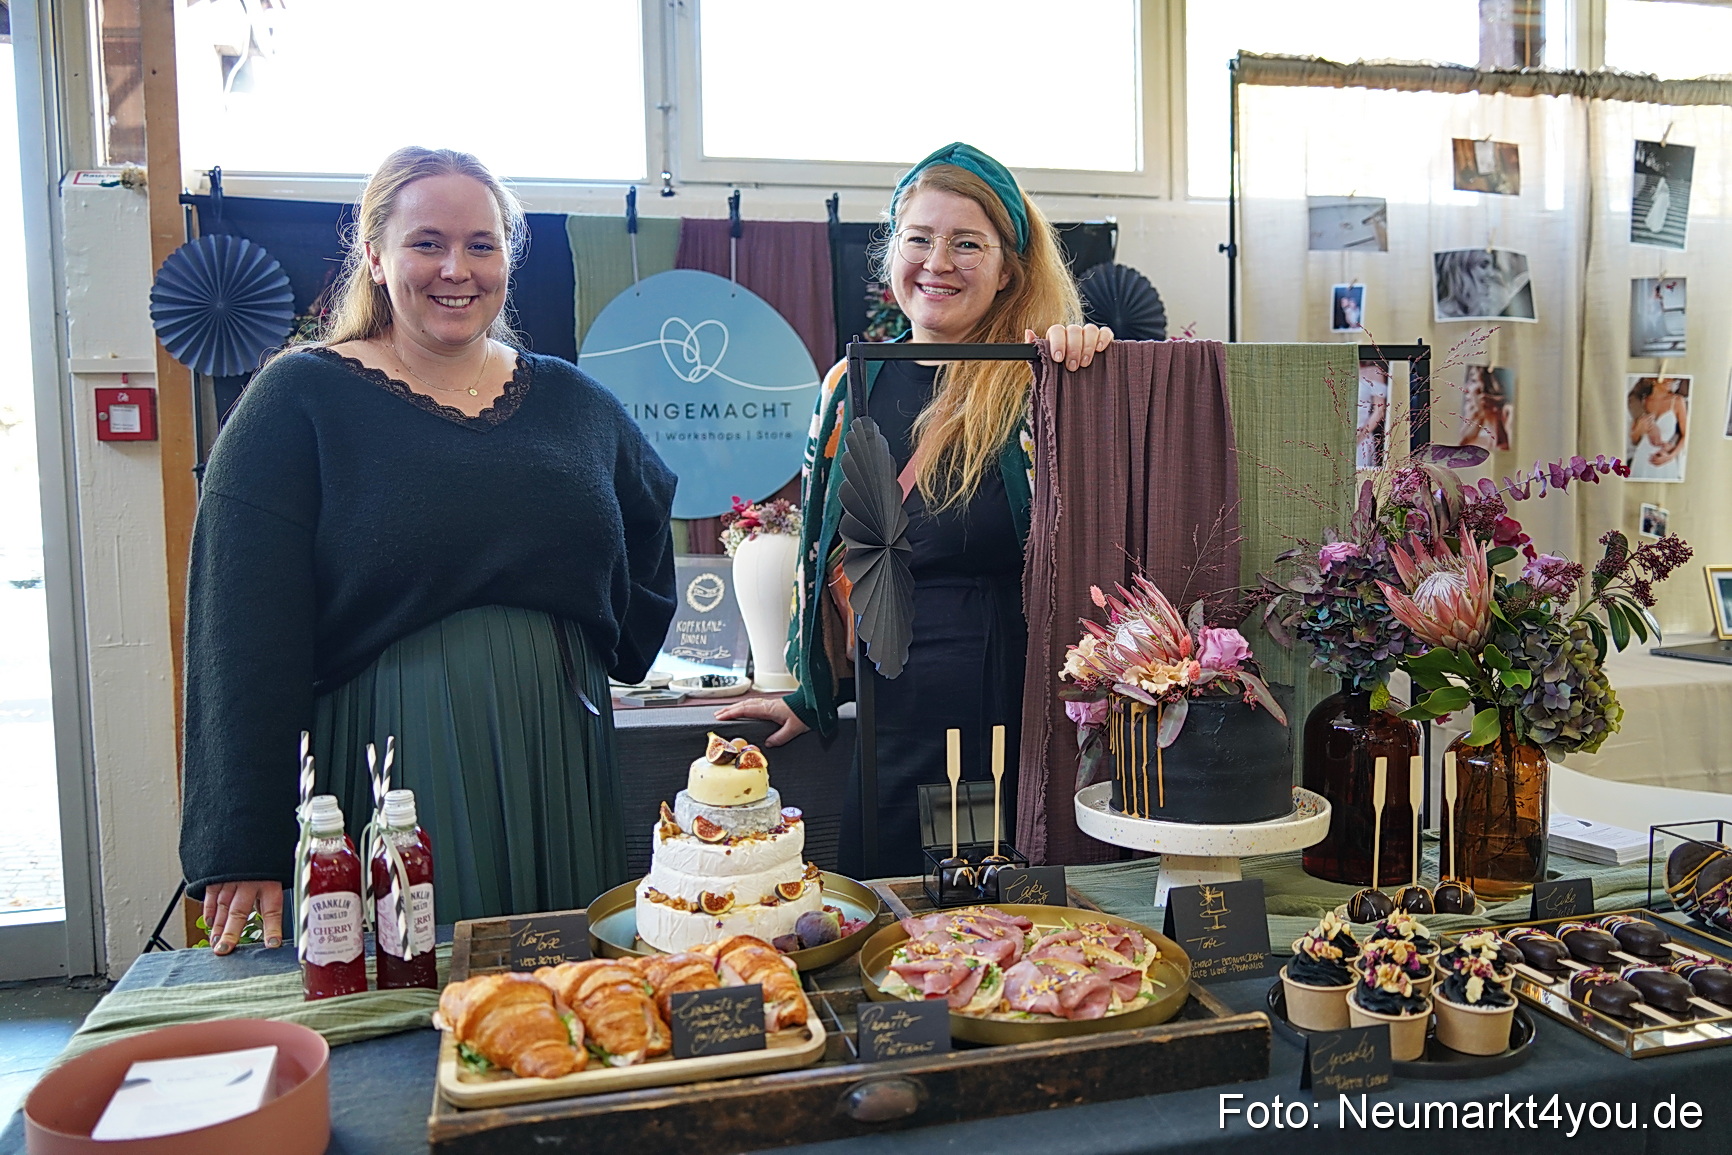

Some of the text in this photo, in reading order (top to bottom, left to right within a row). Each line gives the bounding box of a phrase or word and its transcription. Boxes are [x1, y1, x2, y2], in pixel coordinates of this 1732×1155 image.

[625, 402, 792, 420] INGEMACHT
[666, 430, 793, 442] Workshops Store
[312, 898, 351, 913] FRANKLIN
[338, 910, 348, 918] LTD
[313, 923, 352, 936] CHERRY
